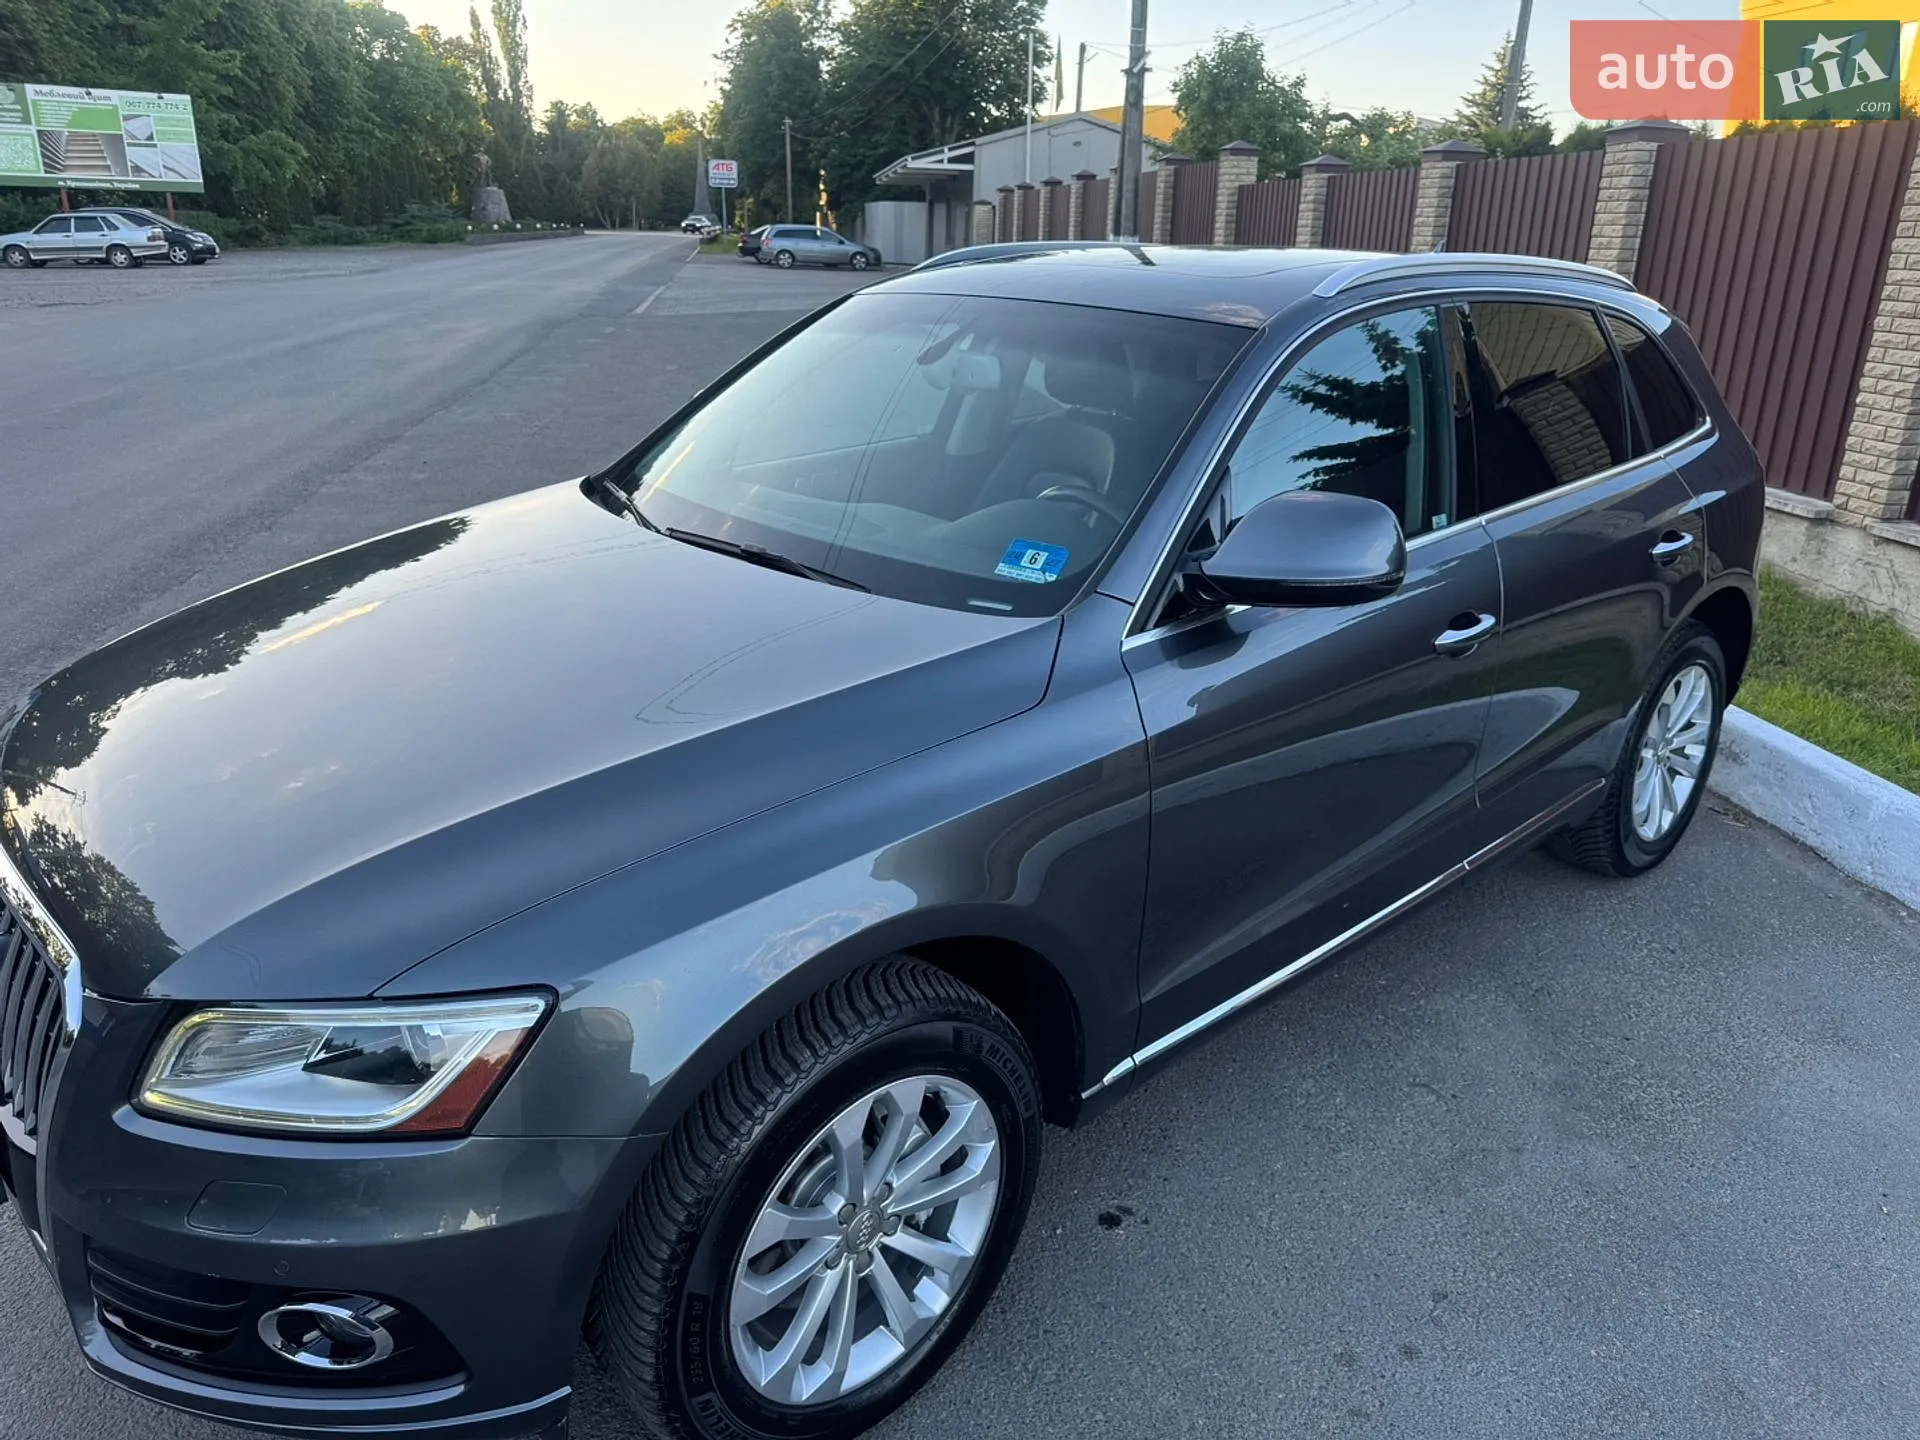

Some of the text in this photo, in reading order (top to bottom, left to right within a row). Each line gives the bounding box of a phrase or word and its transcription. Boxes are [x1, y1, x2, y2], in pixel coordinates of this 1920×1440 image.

[1029, 552, 1040, 565] 6
[985, 1042, 1033, 1115] MICHELIN
[697, 1398, 750, 1440] HELIN
